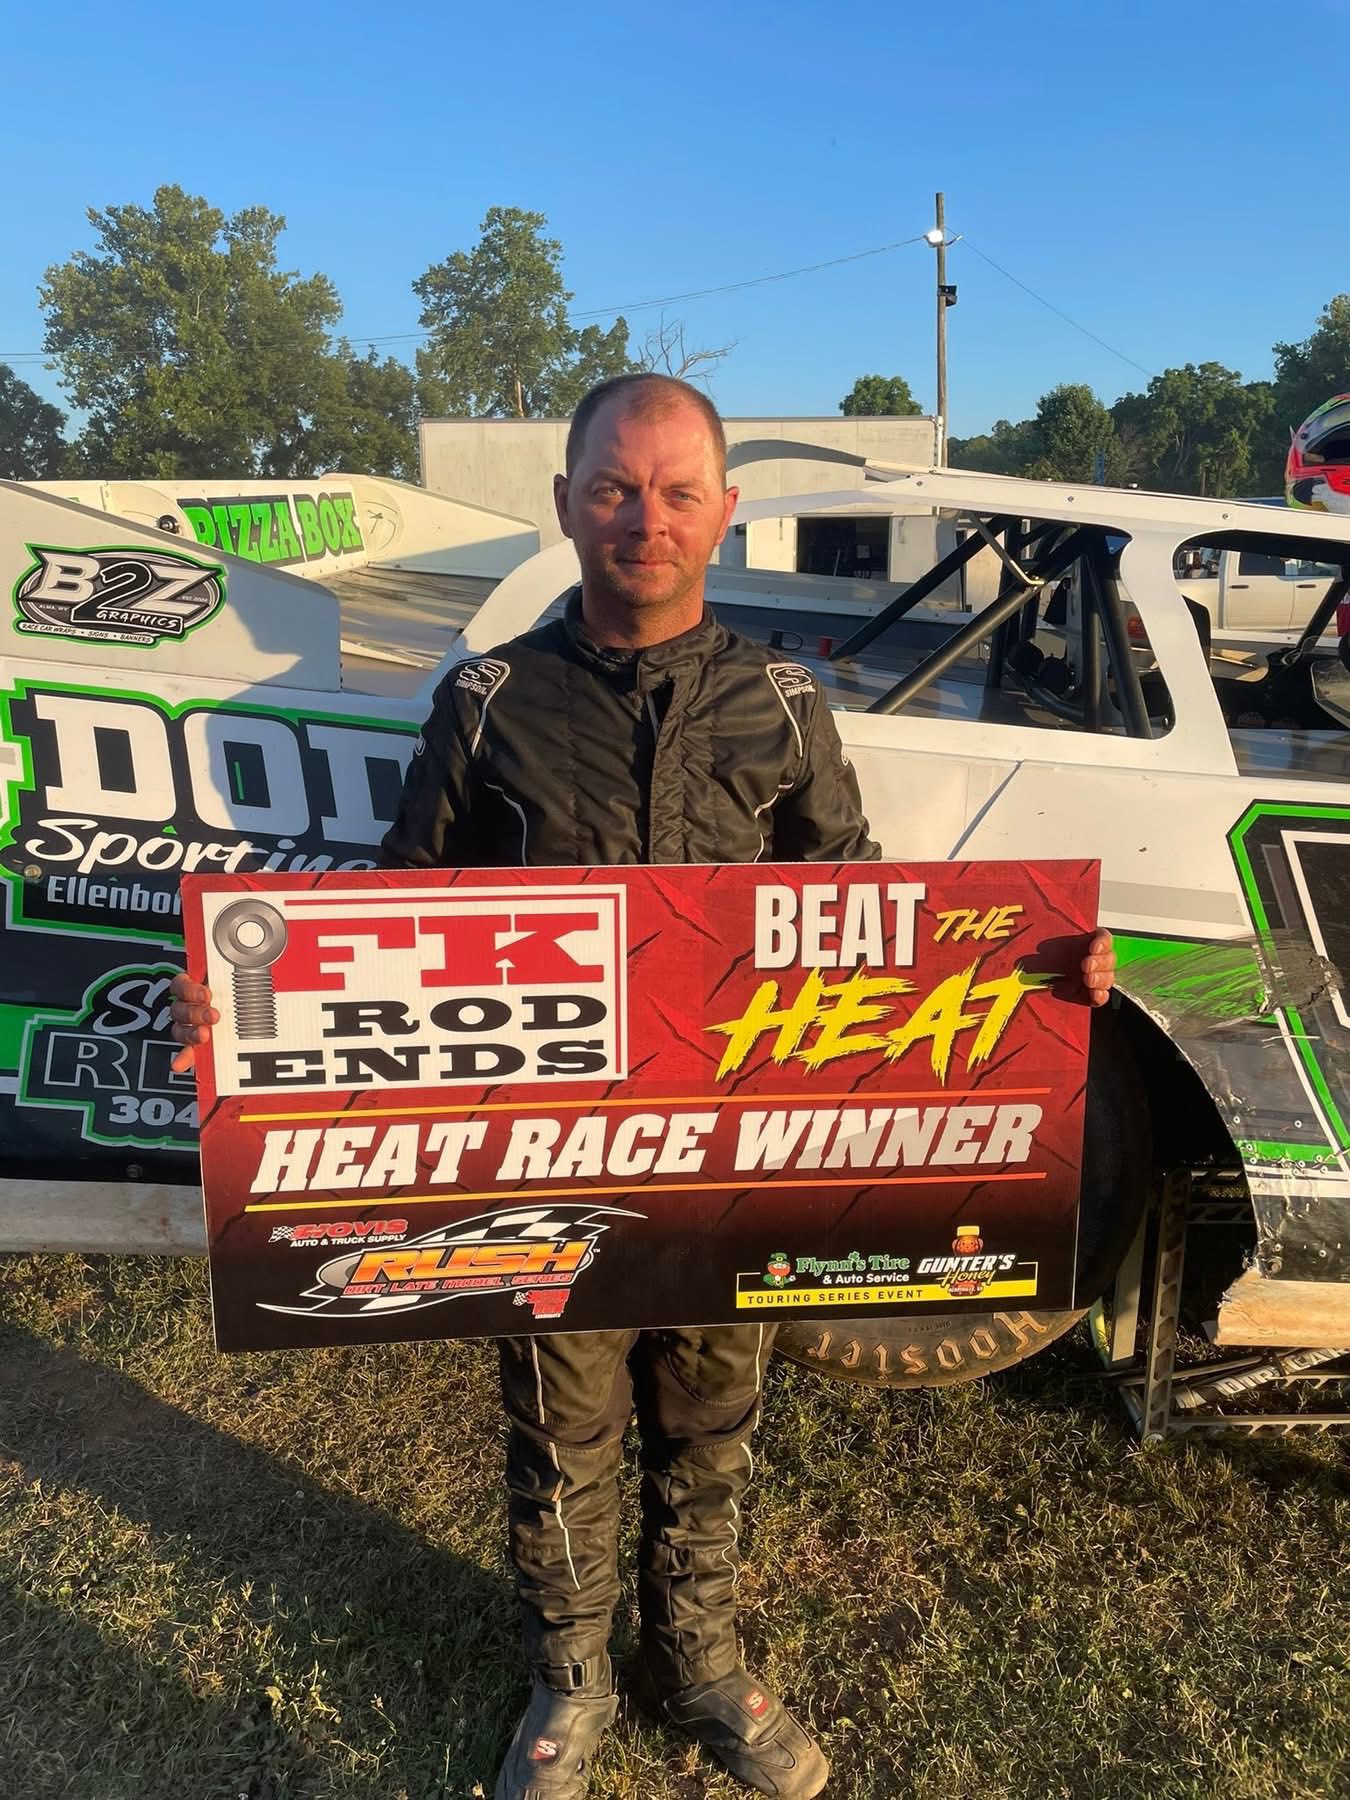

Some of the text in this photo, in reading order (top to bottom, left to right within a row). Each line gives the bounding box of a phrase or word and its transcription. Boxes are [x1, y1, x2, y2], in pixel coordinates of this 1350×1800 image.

[181, 498, 363, 563] PIZZA BOX
[28, 552, 212, 622] B2Z
[96, 610, 179, 628] GRAPHICS
[22, 623, 38, 631] RACE
[53, 626, 76, 635] WRAPS
[88, 630, 109, 638] SIGNS
[120, 633, 151, 643] BANNERS
[754, 882, 1023, 969] BEAT THE
[272, 911, 604, 992] FK
[321, 994, 608, 1038] ROD
[703, 957, 1062, 1087] HEAT
[237, 1039, 608, 1088] ENDS
[249, 1103, 1044, 1194] HEAT RACE WINNER
[290, 1218, 408, 1240] HOVIS
[290, 1233, 407, 1248] AUTO & TRUCK SUPPLY
[351, 1240, 589, 1283] RUSH
[796, 1251, 911, 1277] Flynn's Tire
[917, 1254, 1016, 1274] GUNTER'S
[343, 1272, 573, 1295] DIRT LATE MODEL SERIES
[822, 1271, 910, 1285] & Auto Service
[936, 1267, 997, 1288] Honey
[747, 1289, 923, 1304] TOURING SERIES EVENT
